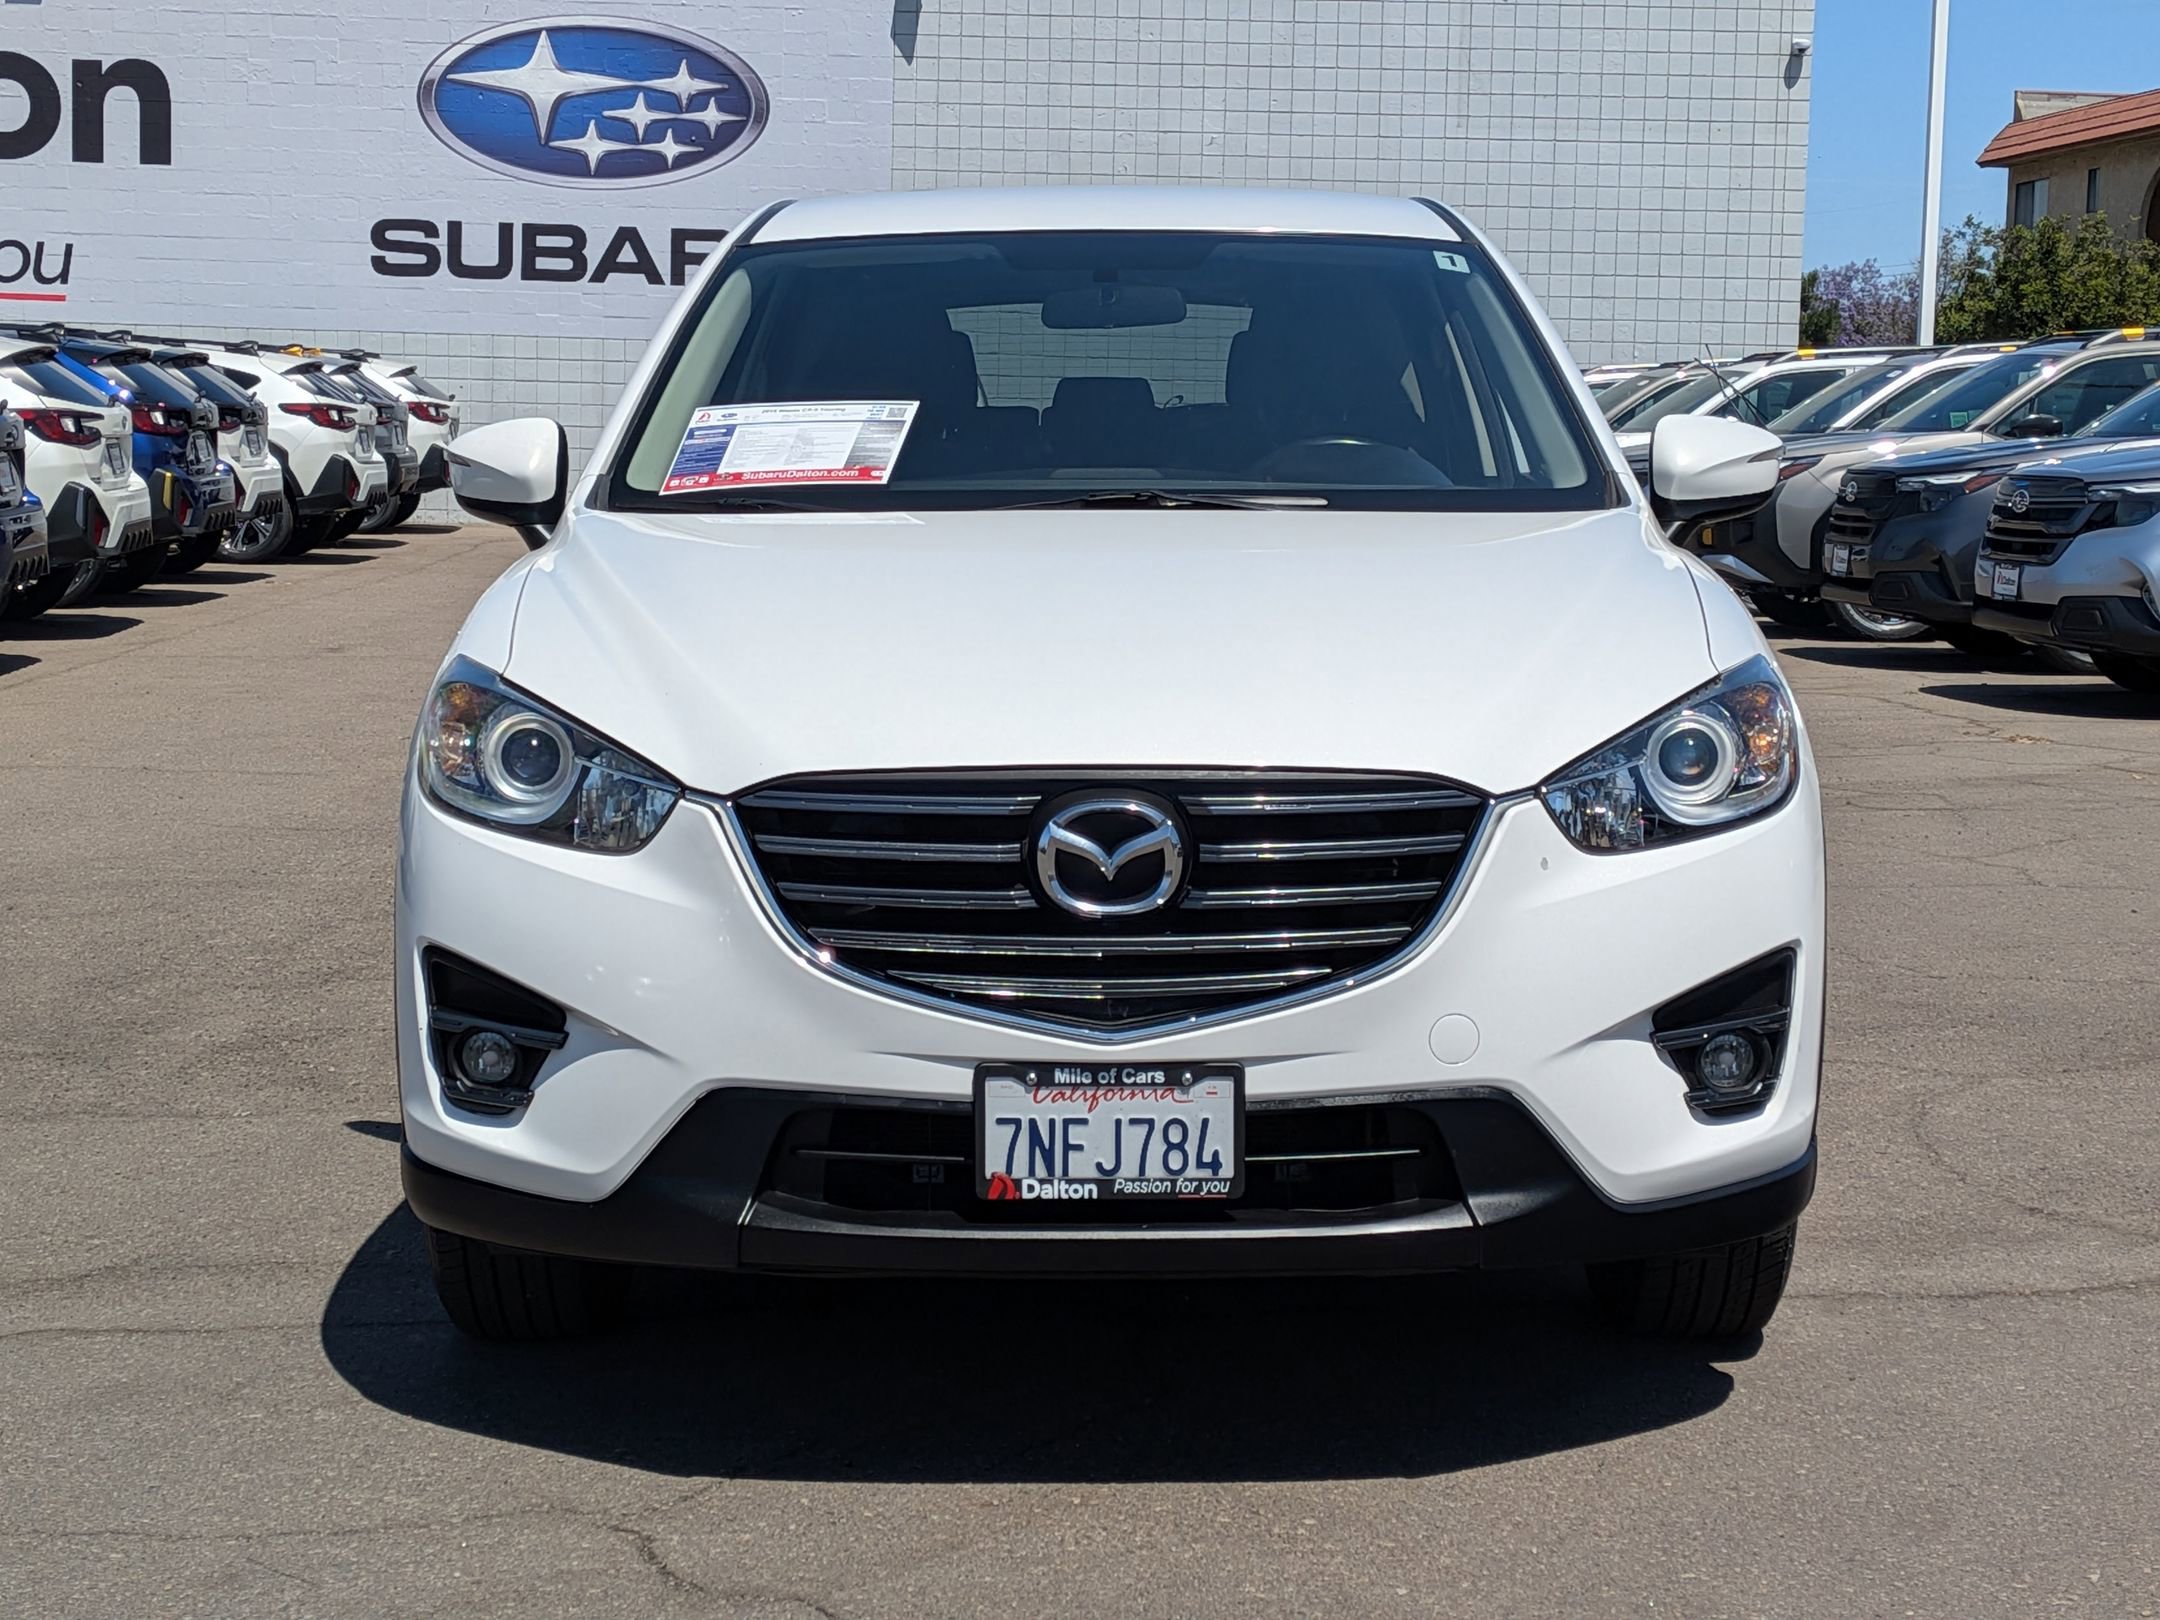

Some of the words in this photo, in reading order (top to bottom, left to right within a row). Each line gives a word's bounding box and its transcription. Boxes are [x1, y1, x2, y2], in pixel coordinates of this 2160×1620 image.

[741, 469, 859, 480] SubaruDalton.com
[1054, 1068, 1092, 1084] Mile
[1097, 1068, 1117, 1084] of
[1122, 1068, 1165, 1084] Cars
[1032, 1086, 1194, 1114] California
[995, 1117, 1223, 1177] 7NFJ784
[1021, 1179, 1098, 1199] Dalton
[1113, 1179, 1172, 1194] Passion
[1175, 1179, 1197, 1194] for
[1199, 1181, 1230, 1198] you
